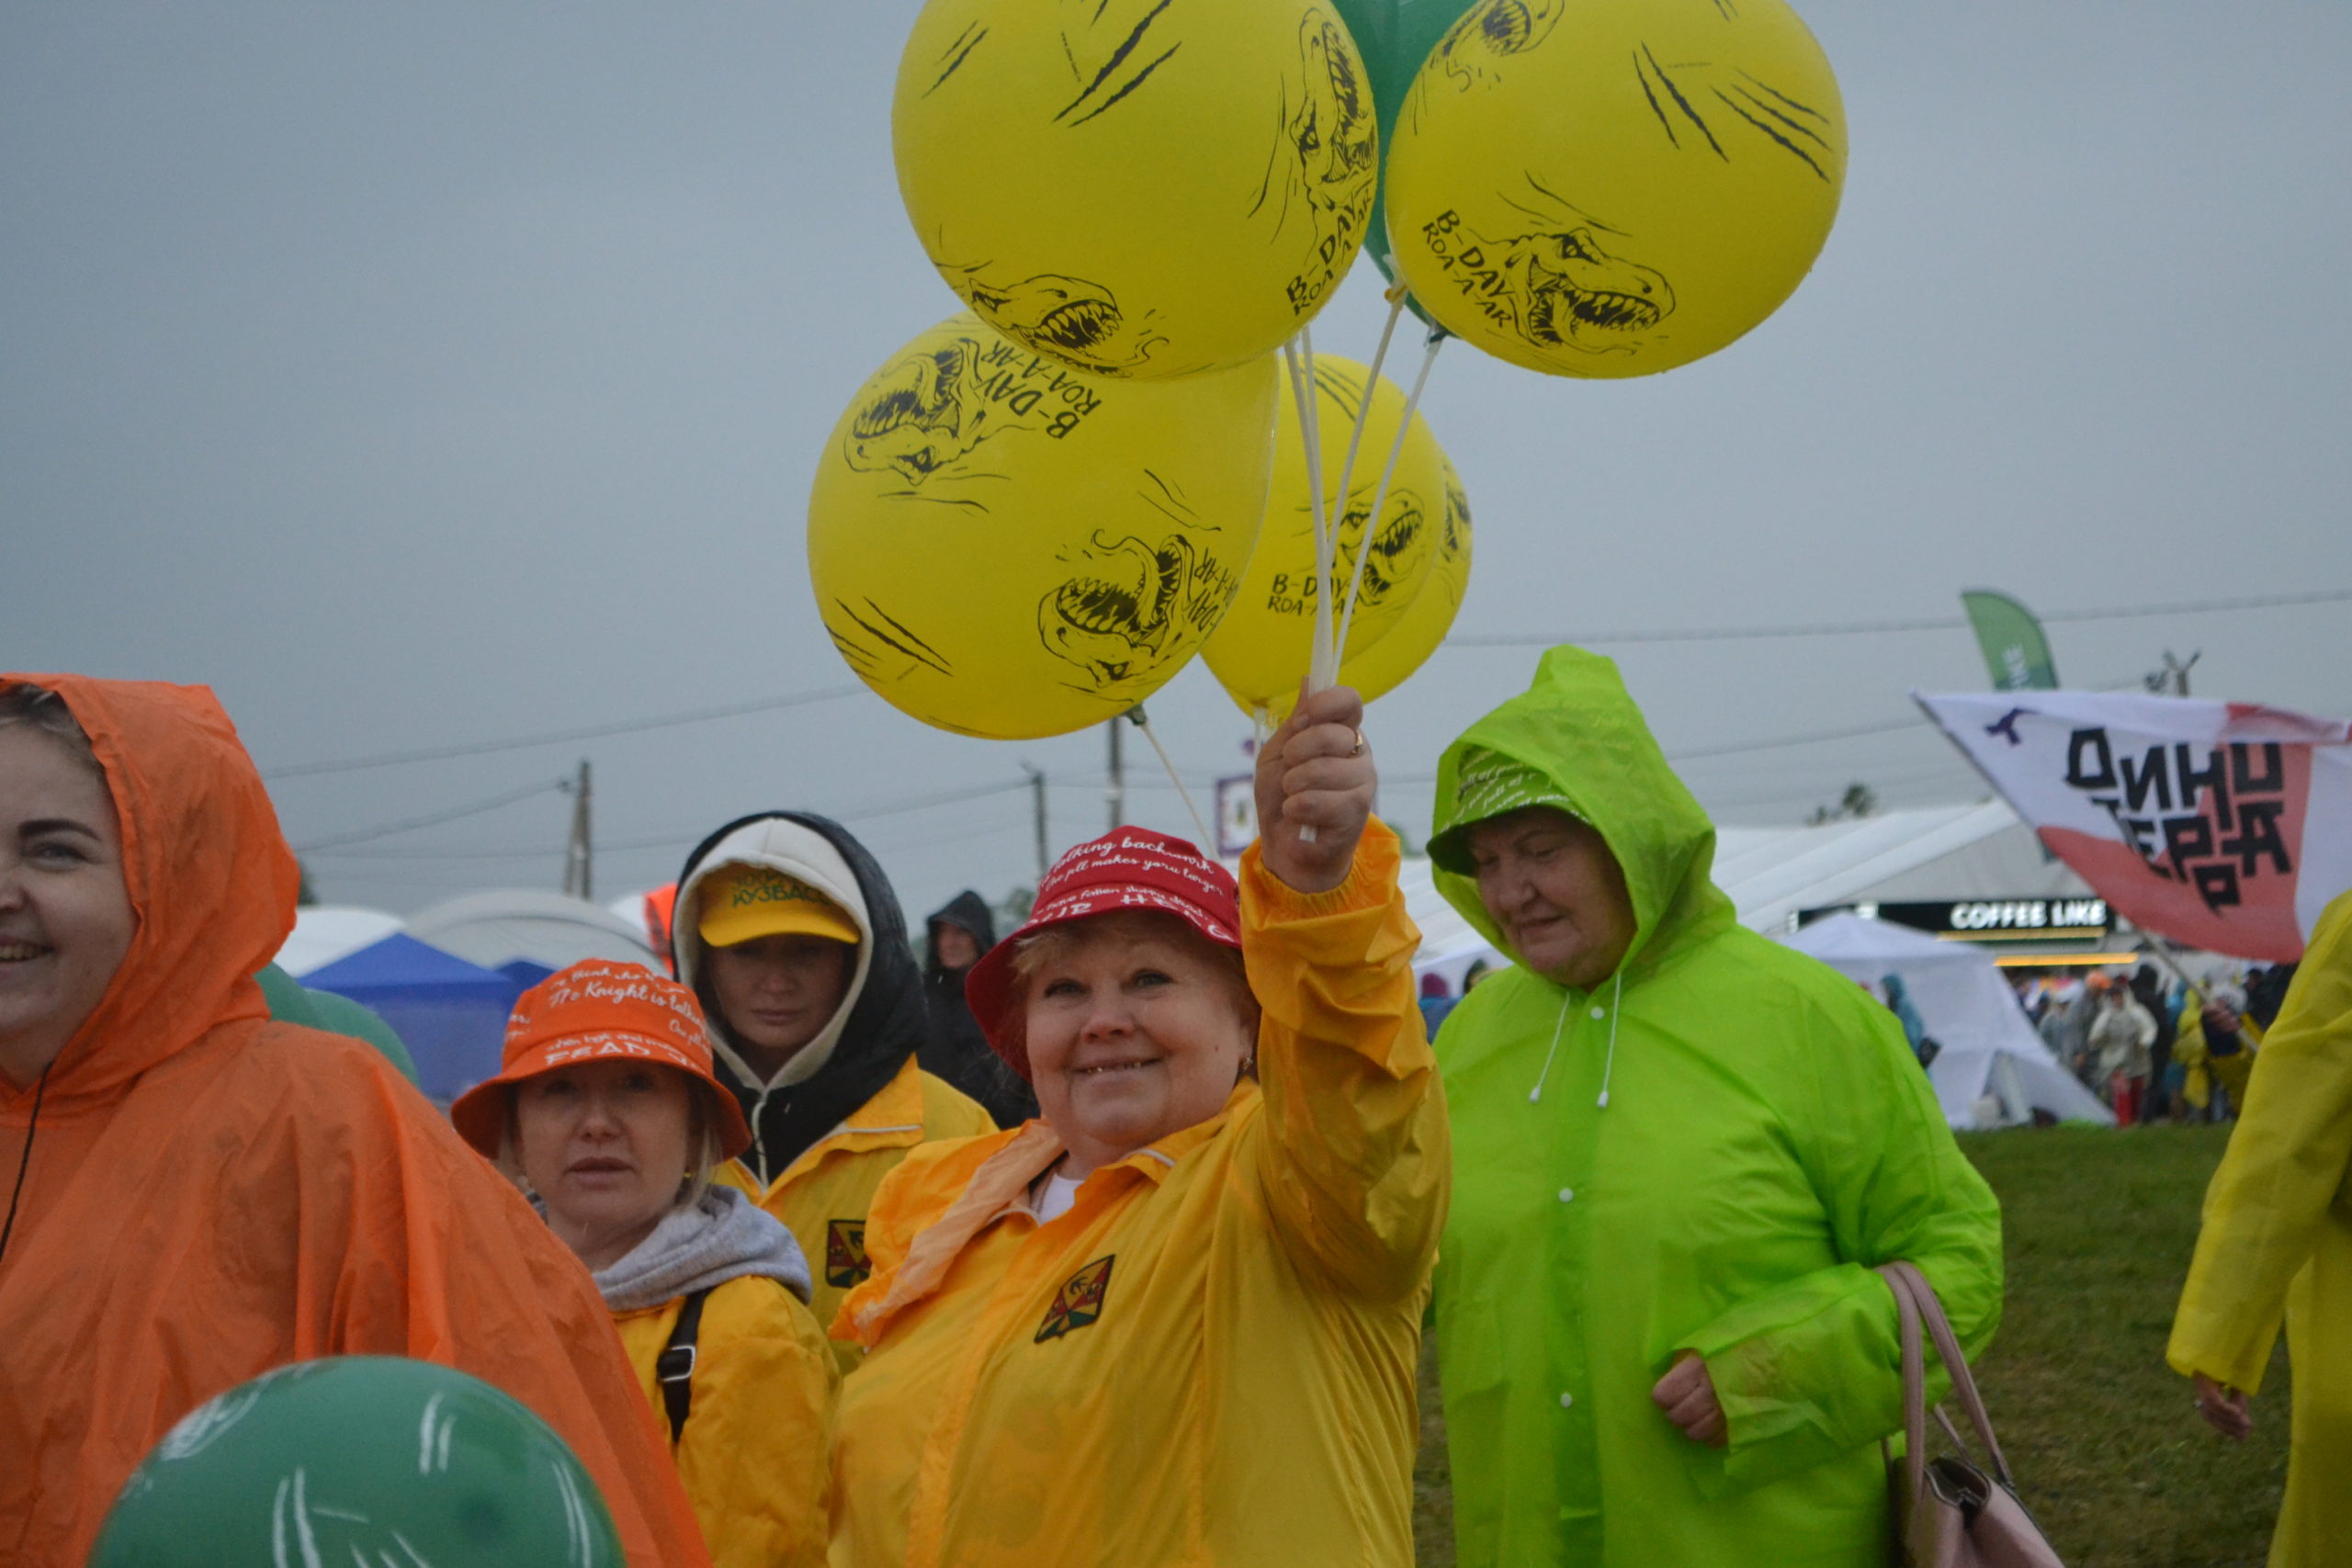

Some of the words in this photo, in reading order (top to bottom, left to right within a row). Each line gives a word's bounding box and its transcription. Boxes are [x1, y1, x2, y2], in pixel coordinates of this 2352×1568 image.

[1286, 190, 1357, 303] B-DAY
[1422, 221, 1512, 328] ROA-A-AR
[1435, 209, 1516, 299] B-DAY
[974, 369, 1080, 439] B-DAY
[980, 340, 1102, 416] ROA-A-AR
[1272, 573, 1349, 598] B-DY
[1091, 854, 1139, 868] makes
[1950, 901, 2047, 930] COFFEE
[2052, 899, 2108, 928] LIKE
[585, 980, 648, 1005] Knight
